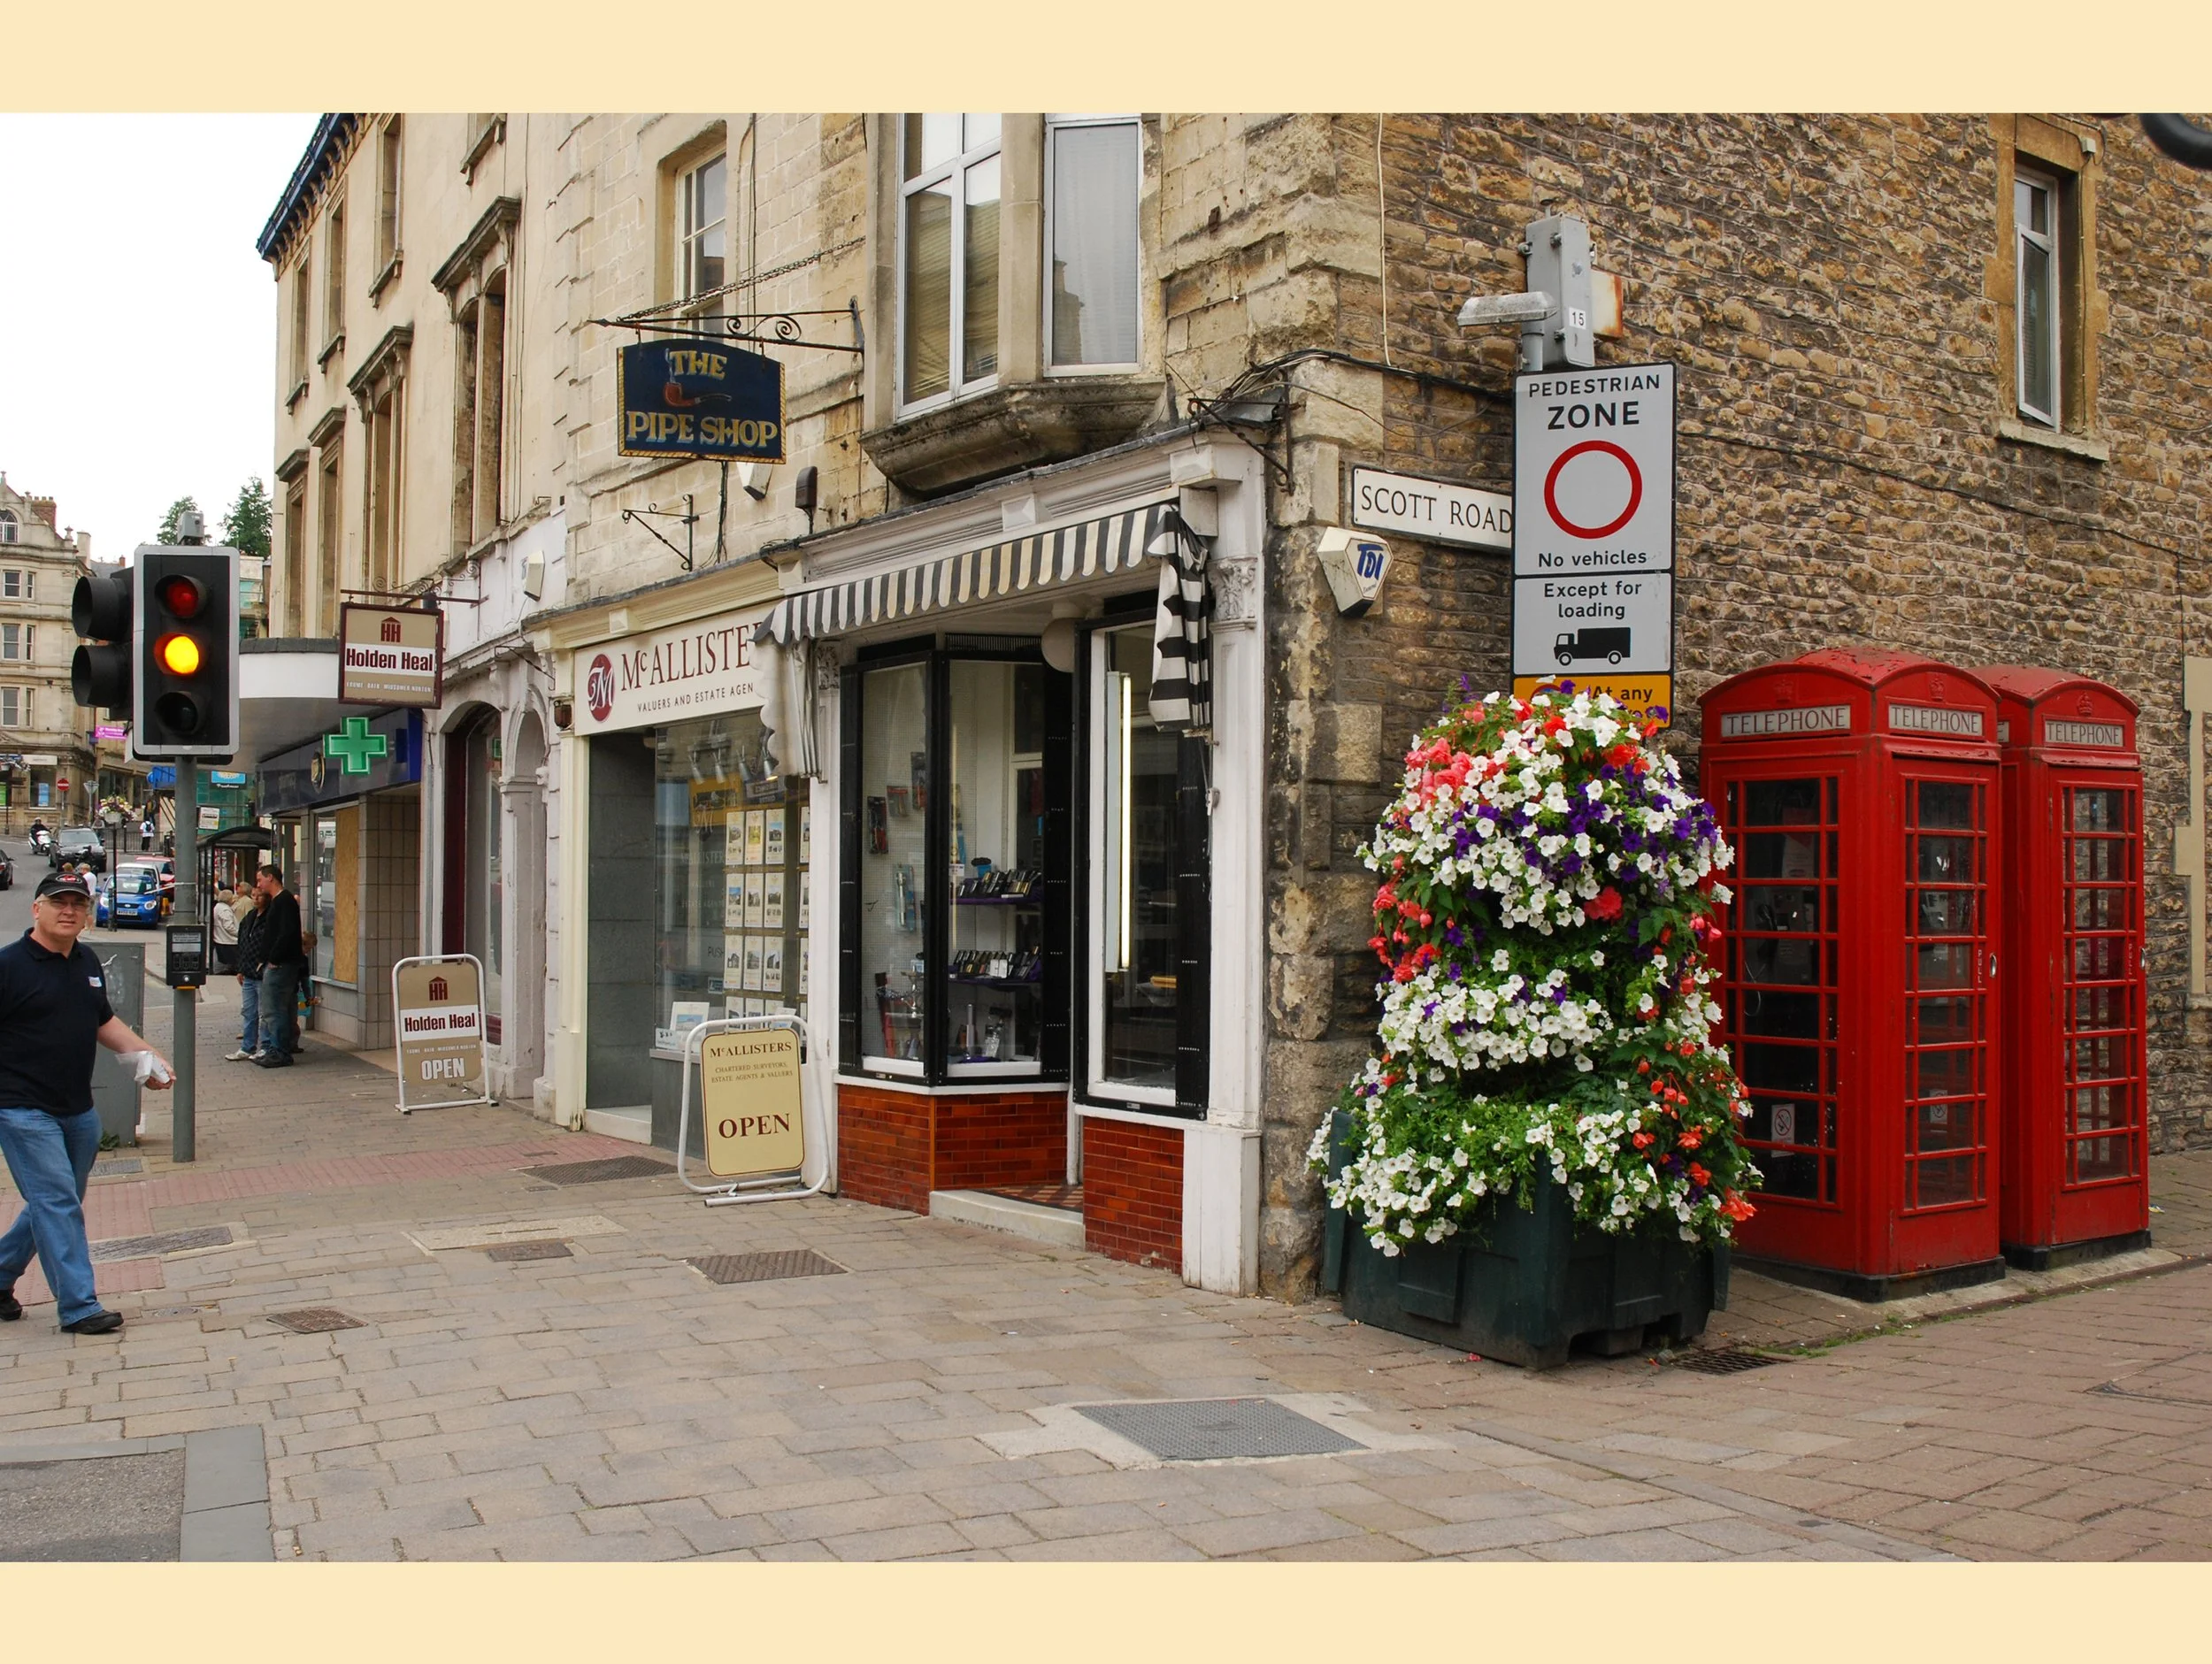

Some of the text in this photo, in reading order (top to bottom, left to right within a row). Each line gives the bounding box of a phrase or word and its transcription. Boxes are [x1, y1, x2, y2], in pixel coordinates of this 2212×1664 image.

[1572, 311, 1584, 326] 15
[669, 350, 727, 380] THE
[1529, 374, 1660, 397] PEDESTRIAN
[1548, 401, 1640, 430] ZONE
[626, 410, 778, 448] PIPE SHOP
[1361, 486, 1512, 533] SCOTT ROAD
[1539, 549, 1647, 568] No vehicles
[1544, 580, 1642, 599] Except for
[1558, 602, 1625, 619] loading
[346, 648, 433, 671] Holden Heal
[638, 698, 671, 712] VALUERS
[674, 694, 691, 706] AND
[695, 688, 726, 703] ESTATE
[1621, 688, 1653, 702] any
[1727, 707, 1846, 735] TELEPHONE
[1892, 707, 1978, 734] TELEPHONE
[2047, 722, 2124, 746] TELEPHONE
[404, 1013, 476, 1032] Holden Heal
[421, 1058, 465, 1081] OPEN
[711, 1075, 733, 1084] ESTATE
[715, 1064, 751, 1074] CHARTERED
[718, 1113, 790, 1139] OPEN
